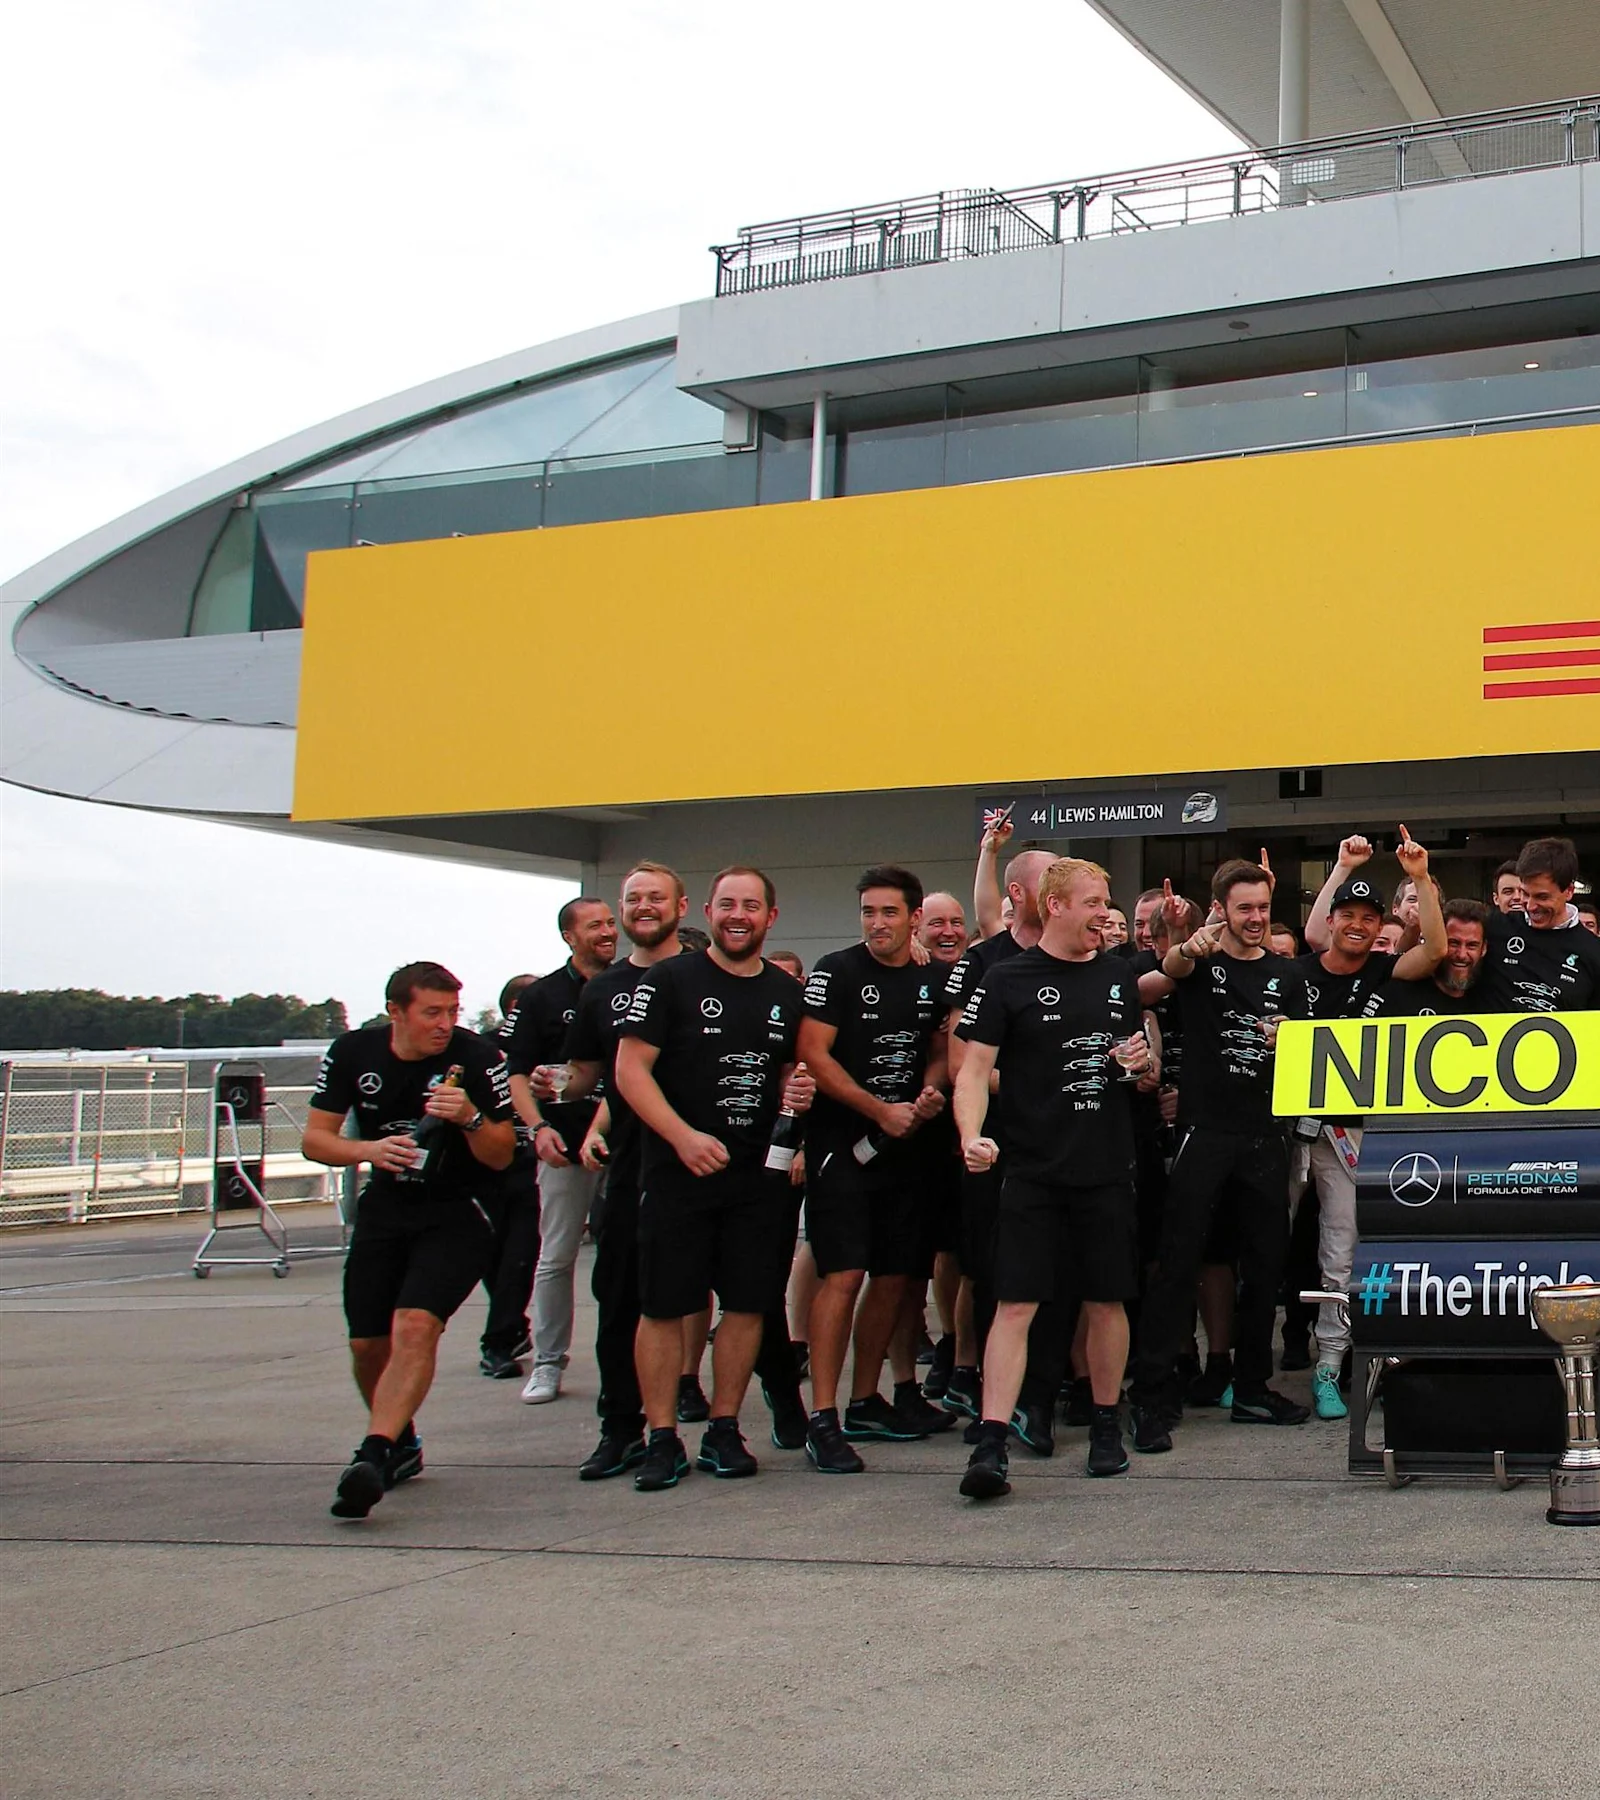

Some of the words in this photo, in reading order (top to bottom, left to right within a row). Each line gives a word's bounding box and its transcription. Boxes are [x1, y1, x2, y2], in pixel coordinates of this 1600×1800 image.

[1030, 810, 1047, 824] 44
[1058, 804, 1096, 823] LEWIS
[1099, 803, 1164, 821] HAMILTON
[1308, 1016, 1577, 1109] NICO
[1530, 1161, 1579, 1171] AMG
[1467, 1172, 1578, 1186] PETRONAS
[1467, 1186, 1519, 1196] FORMULA
[1548, 1185, 1578, 1194] TEAM
